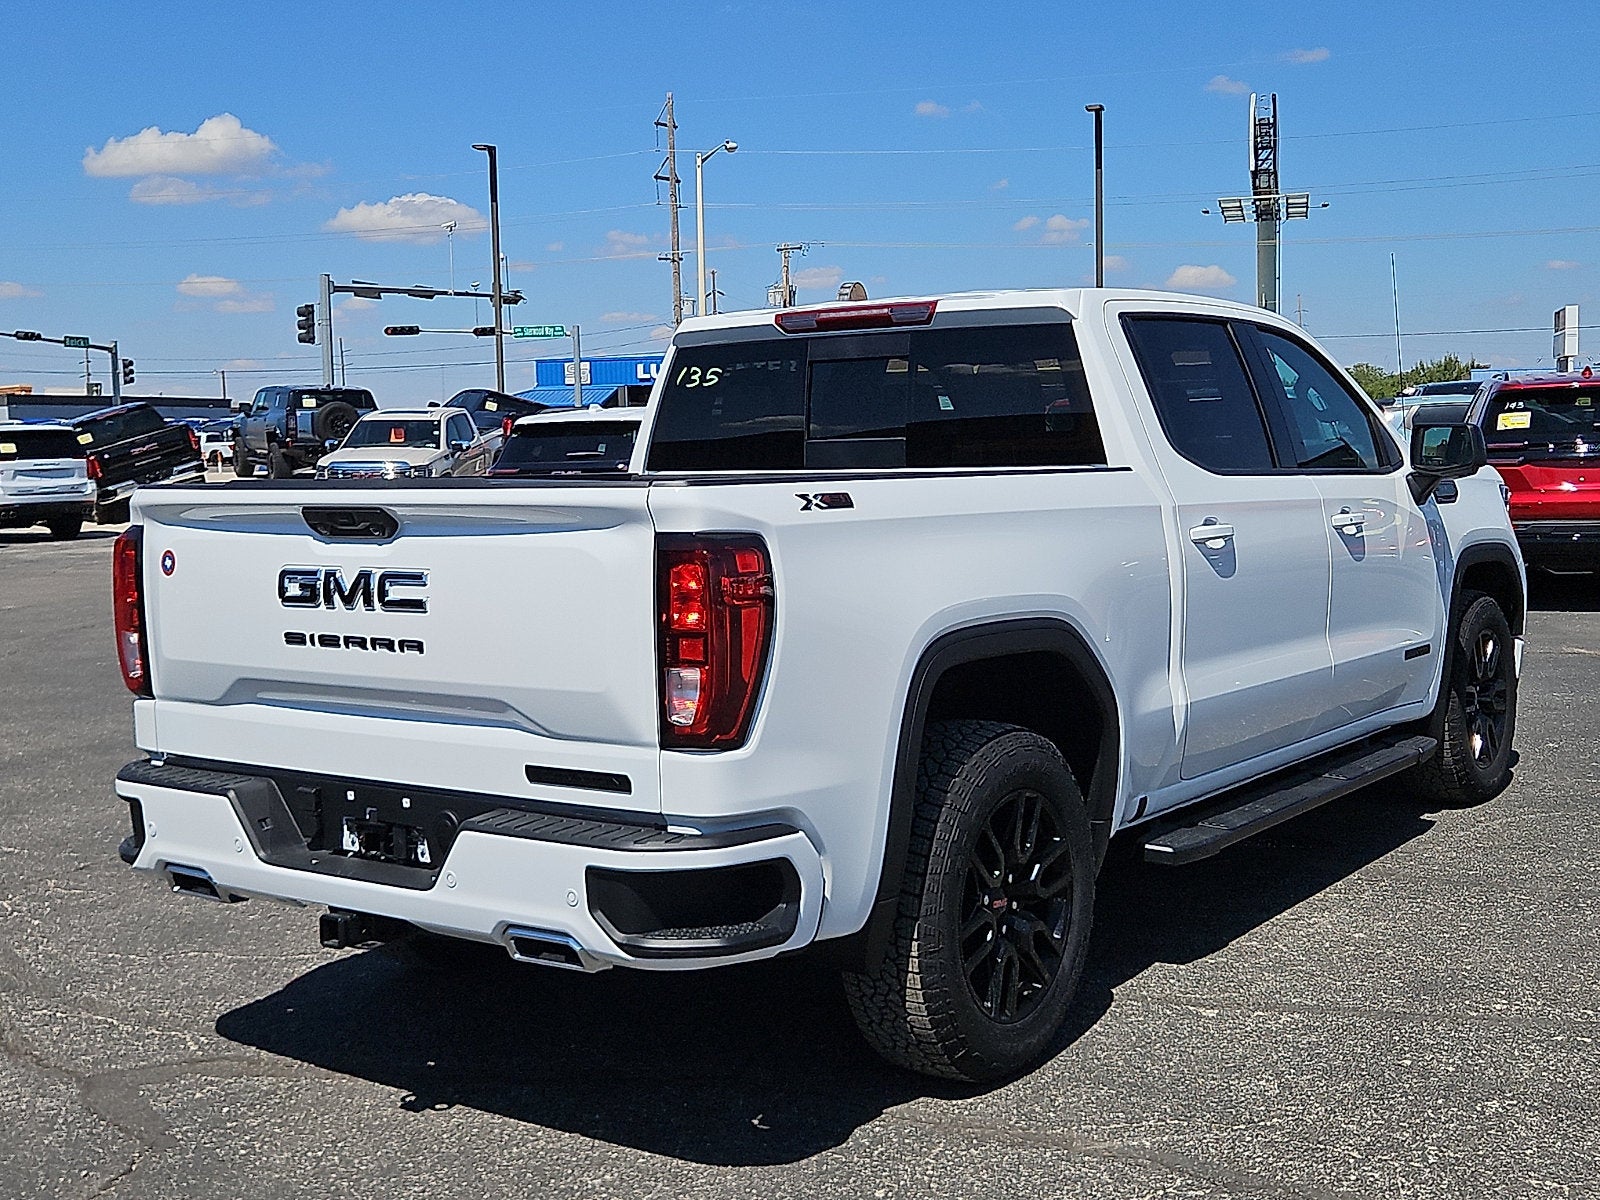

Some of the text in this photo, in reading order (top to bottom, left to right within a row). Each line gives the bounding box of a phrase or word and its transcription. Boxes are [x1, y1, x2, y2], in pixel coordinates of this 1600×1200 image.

[676, 366, 723, 388] 135
[277, 565, 430, 614] GMC
[283, 631, 425, 655] SIERRA
